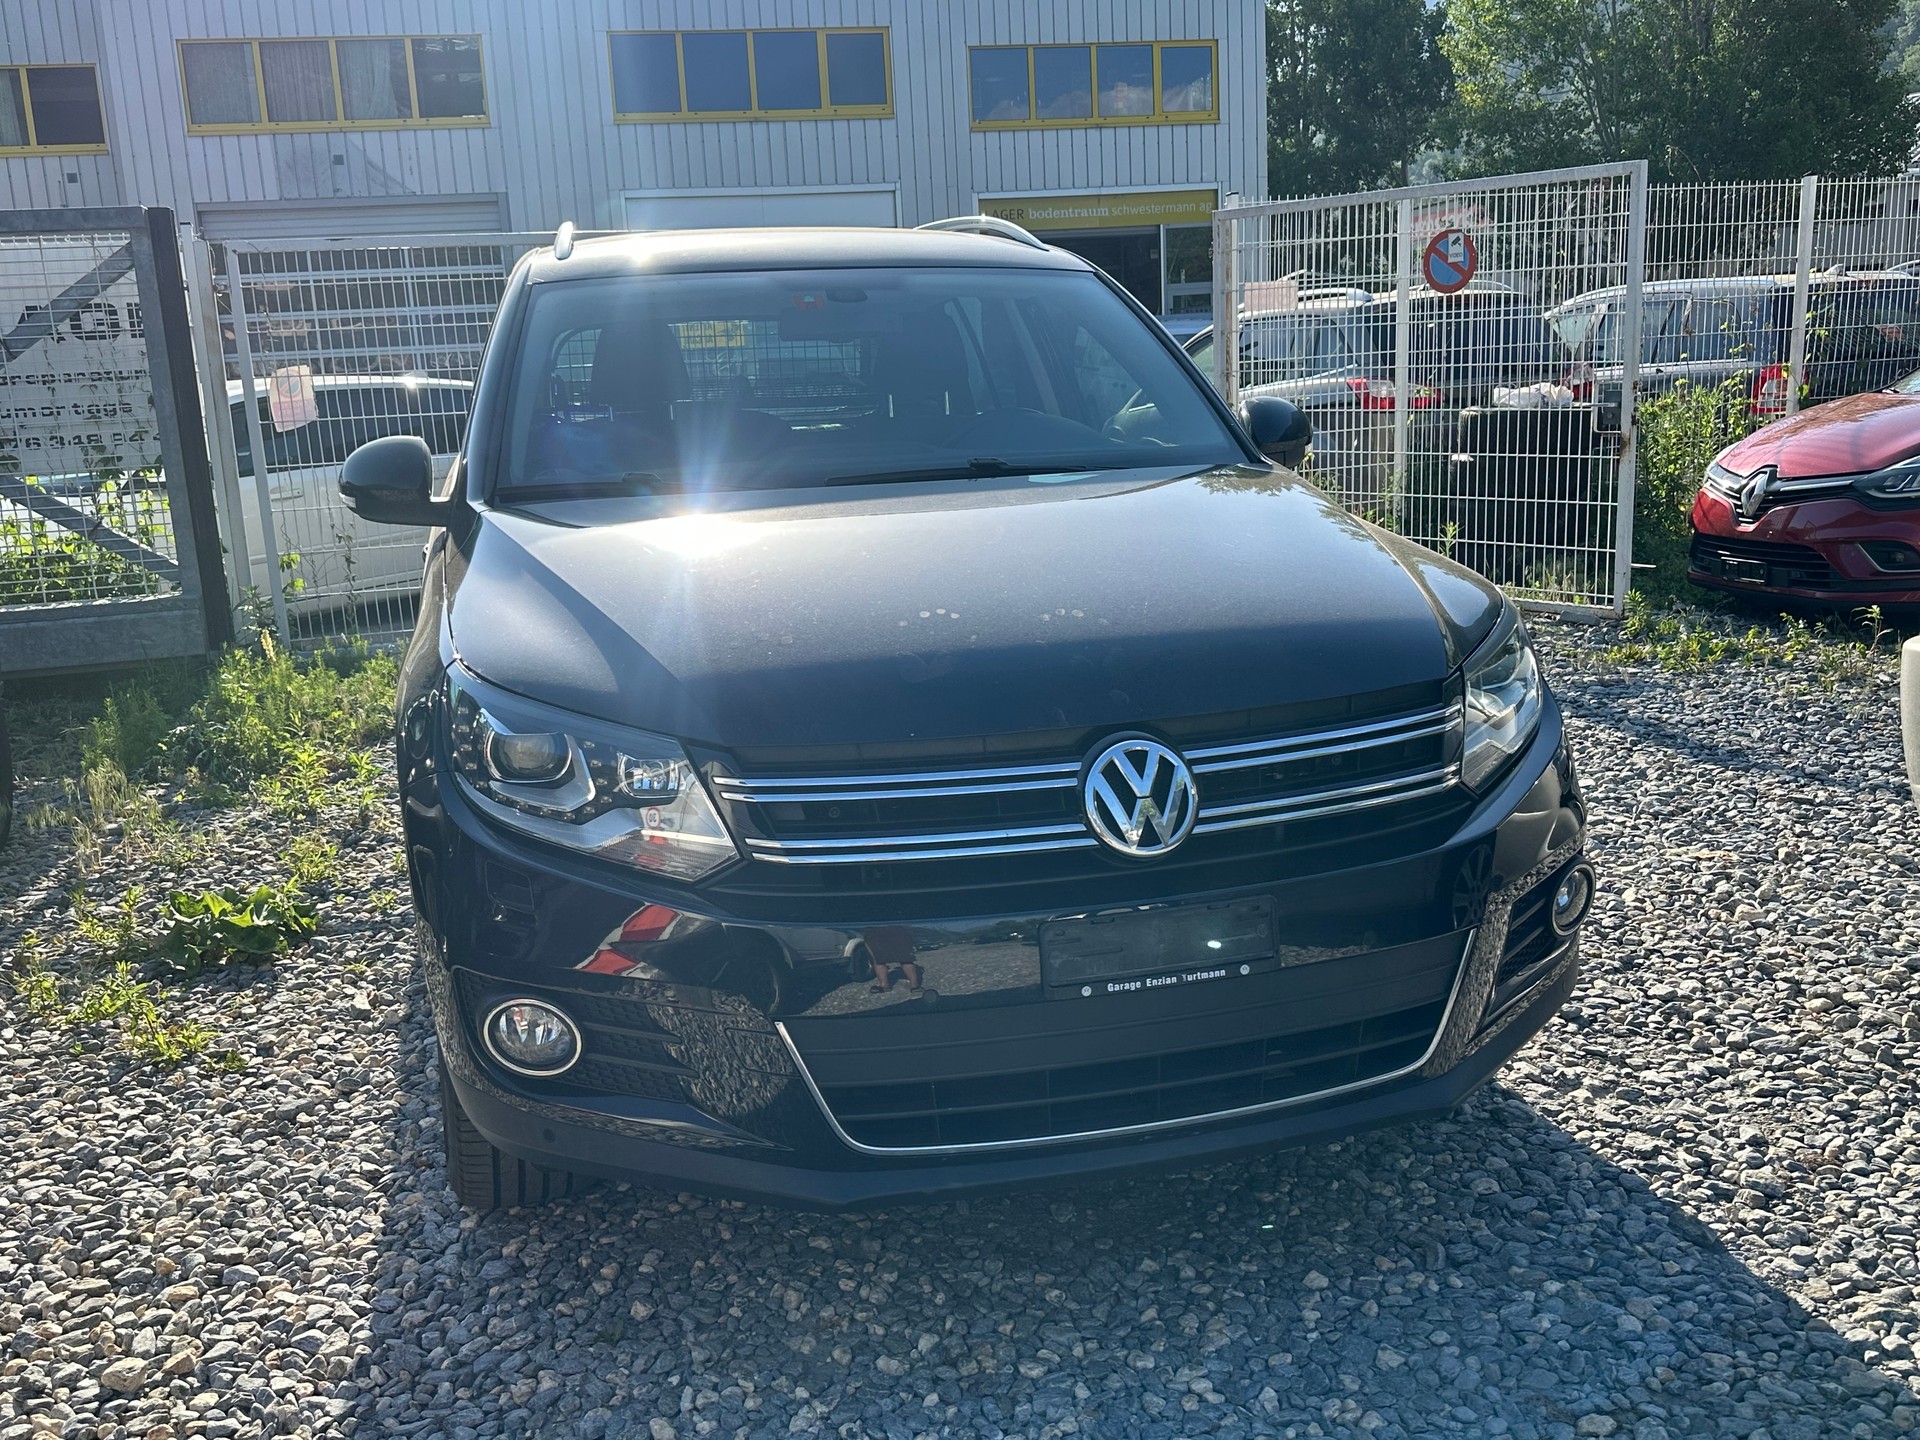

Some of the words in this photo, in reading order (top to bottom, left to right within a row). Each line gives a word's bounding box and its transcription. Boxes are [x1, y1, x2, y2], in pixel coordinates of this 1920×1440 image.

[1029, 205, 1109, 220] bodentraum
[1112, 203, 1196, 216] schwestermann
[1199, 202, 1212, 214] ag
[1085, 739, 1198, 857] VW
[1107, 980, 1142, 992] Garage
[1146, 976, 1177, 987] Enzian
